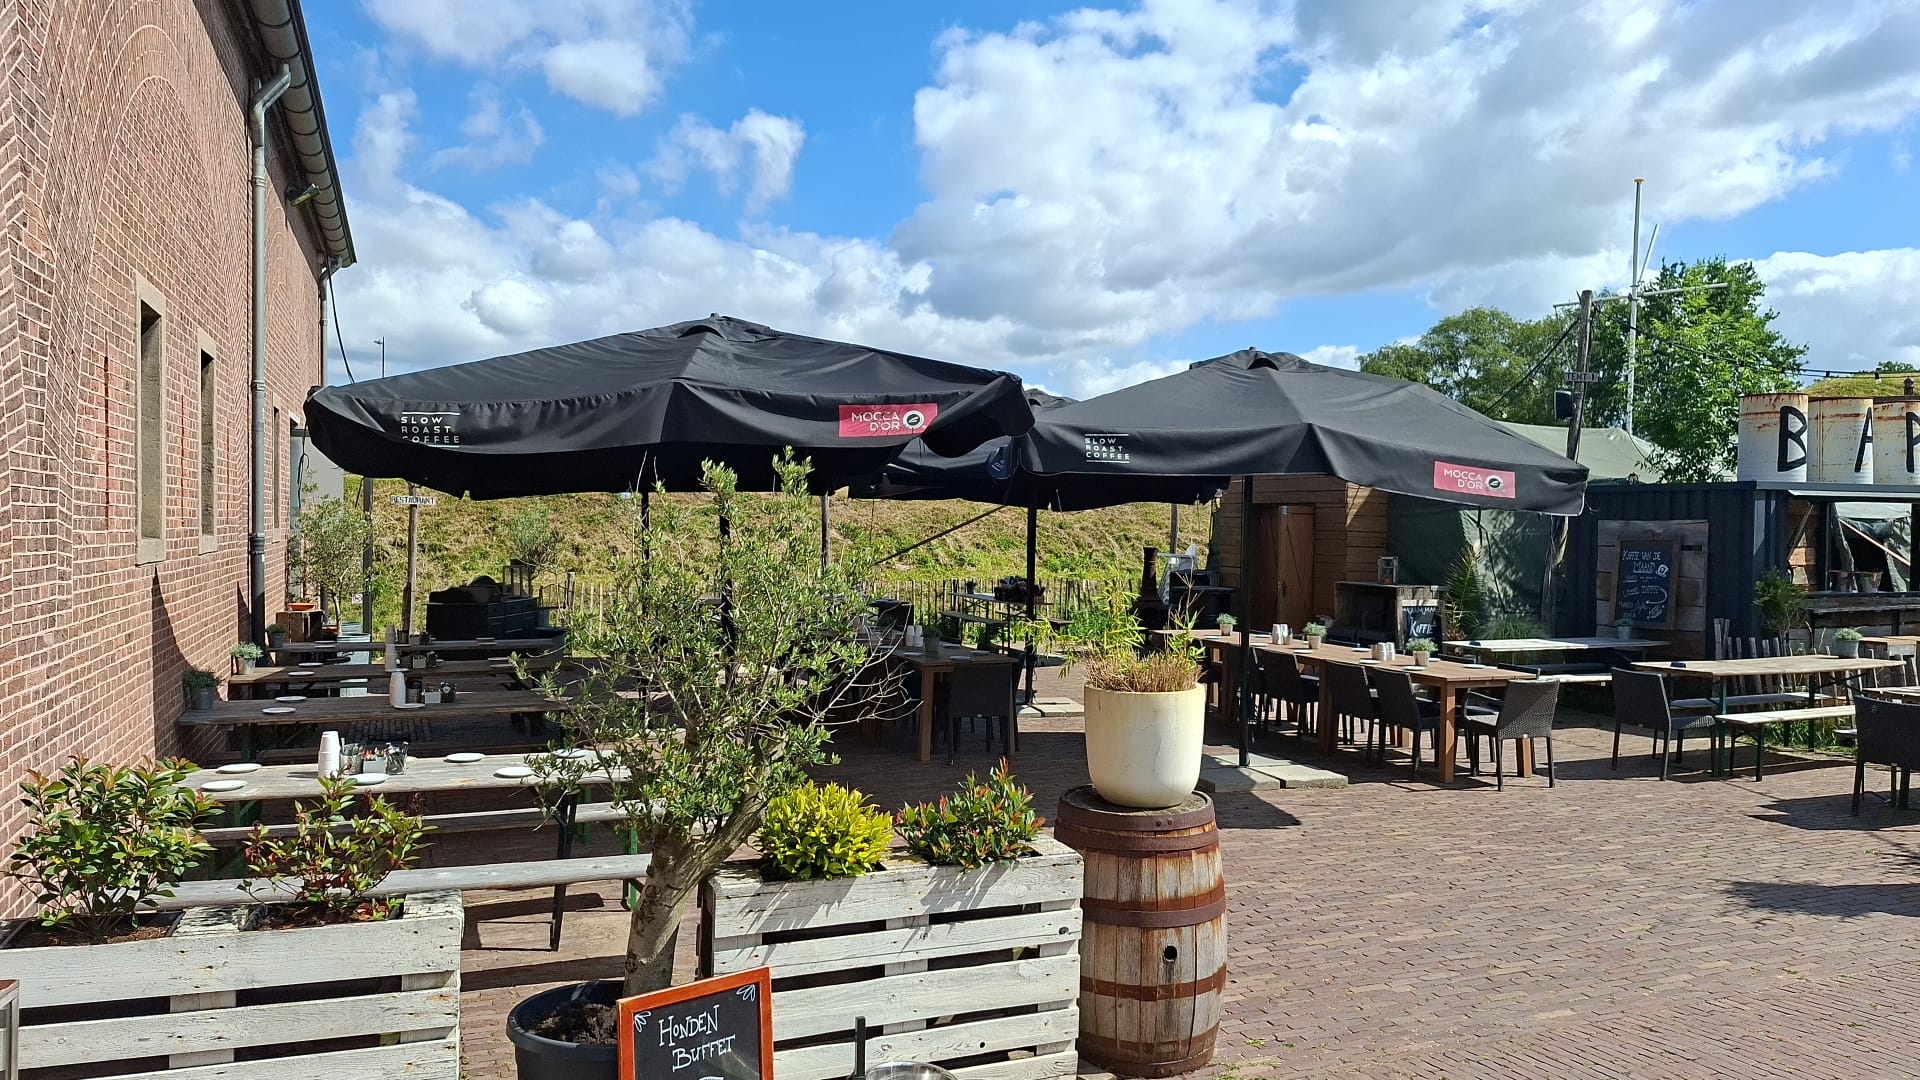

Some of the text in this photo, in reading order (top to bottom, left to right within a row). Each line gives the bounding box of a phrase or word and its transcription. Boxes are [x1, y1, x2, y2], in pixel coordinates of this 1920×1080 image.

[1566, 372, 1587, 381] TENT
[400, 416, 443, 424] SLOW
[851, 411, 900, 422] MOCCA
[401, 425, 451, 434] ROAST
[869, 421, 900, 431] D'OR
[1086, 452, 1130, 460] COFFEE
[1443, 468, 1482, 481] MOCCA
[1457, 479, 1483, 490] D'OR
[658, 1004, 720, 1047] HONDEN
[672, 1034, 736, 1073] BUFFET
